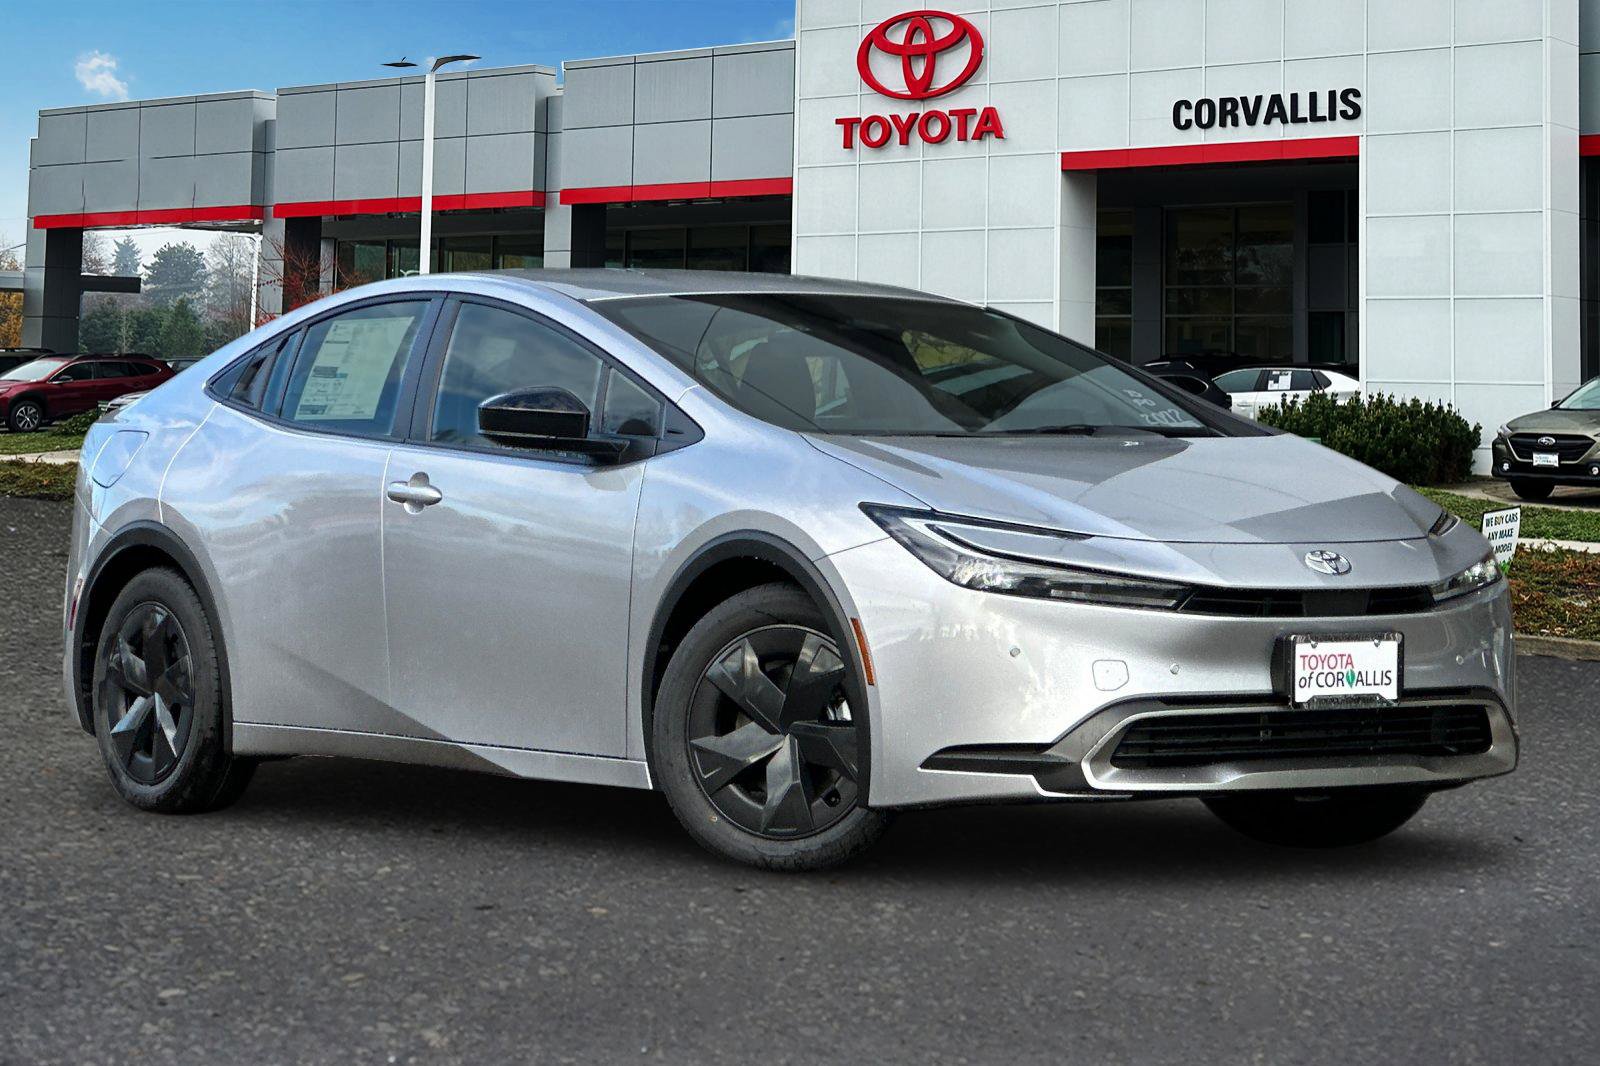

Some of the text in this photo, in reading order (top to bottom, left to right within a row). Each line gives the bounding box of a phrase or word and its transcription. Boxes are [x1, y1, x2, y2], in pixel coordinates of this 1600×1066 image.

[1172, 88, 1361, 130] CORVALLIS
[835, 107, 1005, 149] TOYOTA
[1485, 512, 1518, 527] WE BUY CARS
[1488, 528, 1514, 541] ANY MAKE
[1300, 654, 1355, 670] TOYOTA
[1298, 671, 1314, 688] of
